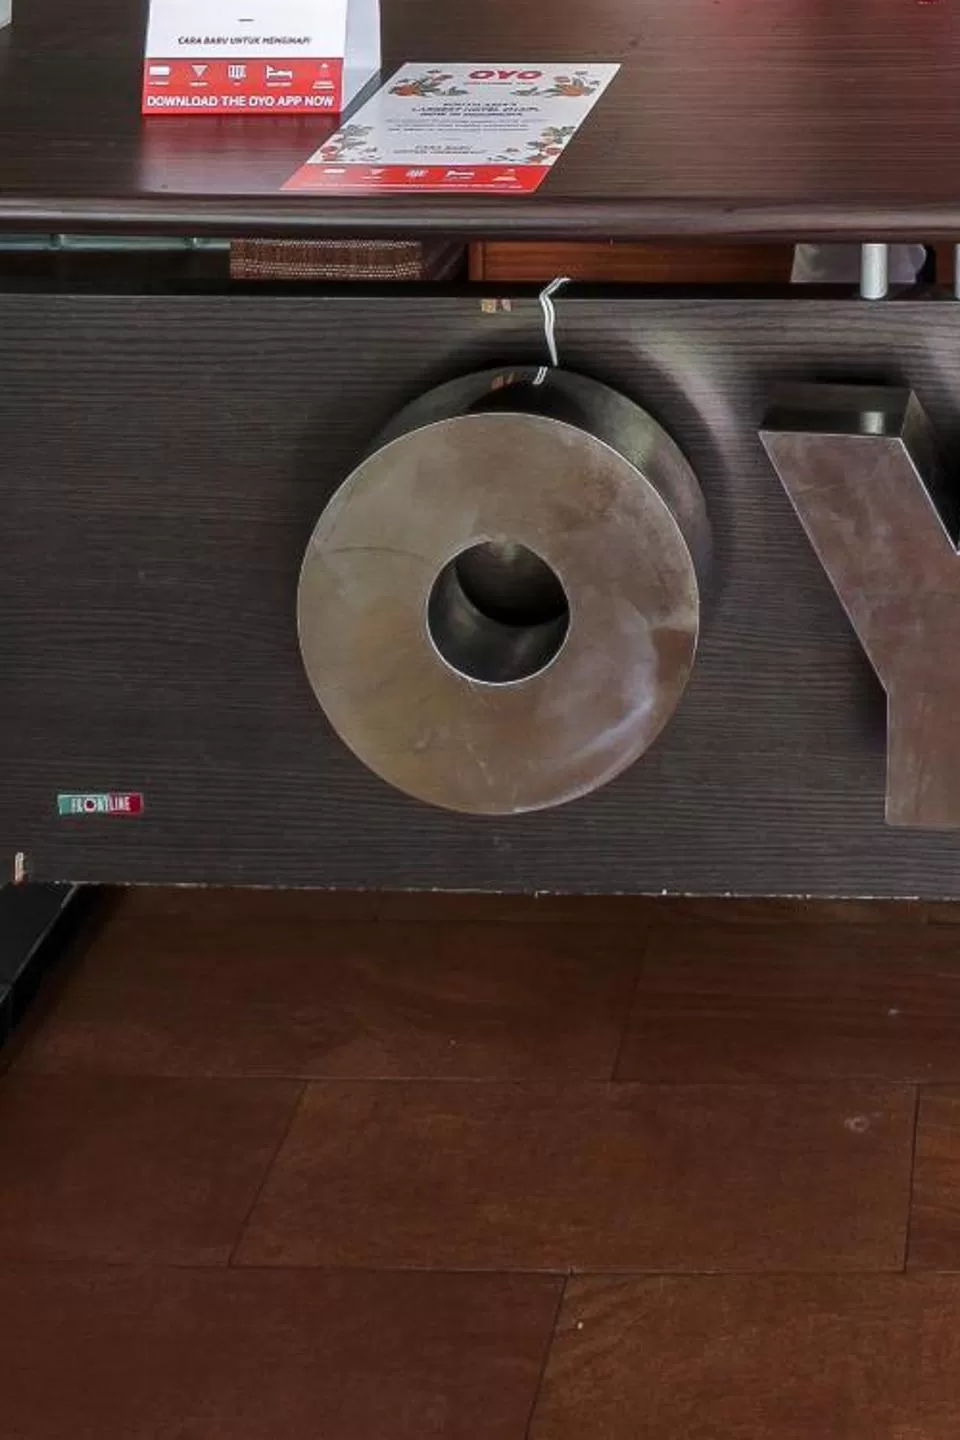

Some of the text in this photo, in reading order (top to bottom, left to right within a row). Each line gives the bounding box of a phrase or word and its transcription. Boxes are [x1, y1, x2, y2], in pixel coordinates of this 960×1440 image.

[178, 36, 202, 45] CARA
[203, 36, 229, 45] BARU
[230, 36, 260, 45] UNTUK
[468, 70, 543, 79] OYO
[147, 95, 334, 107] DOWNLOAD THE OYO APP NOW
